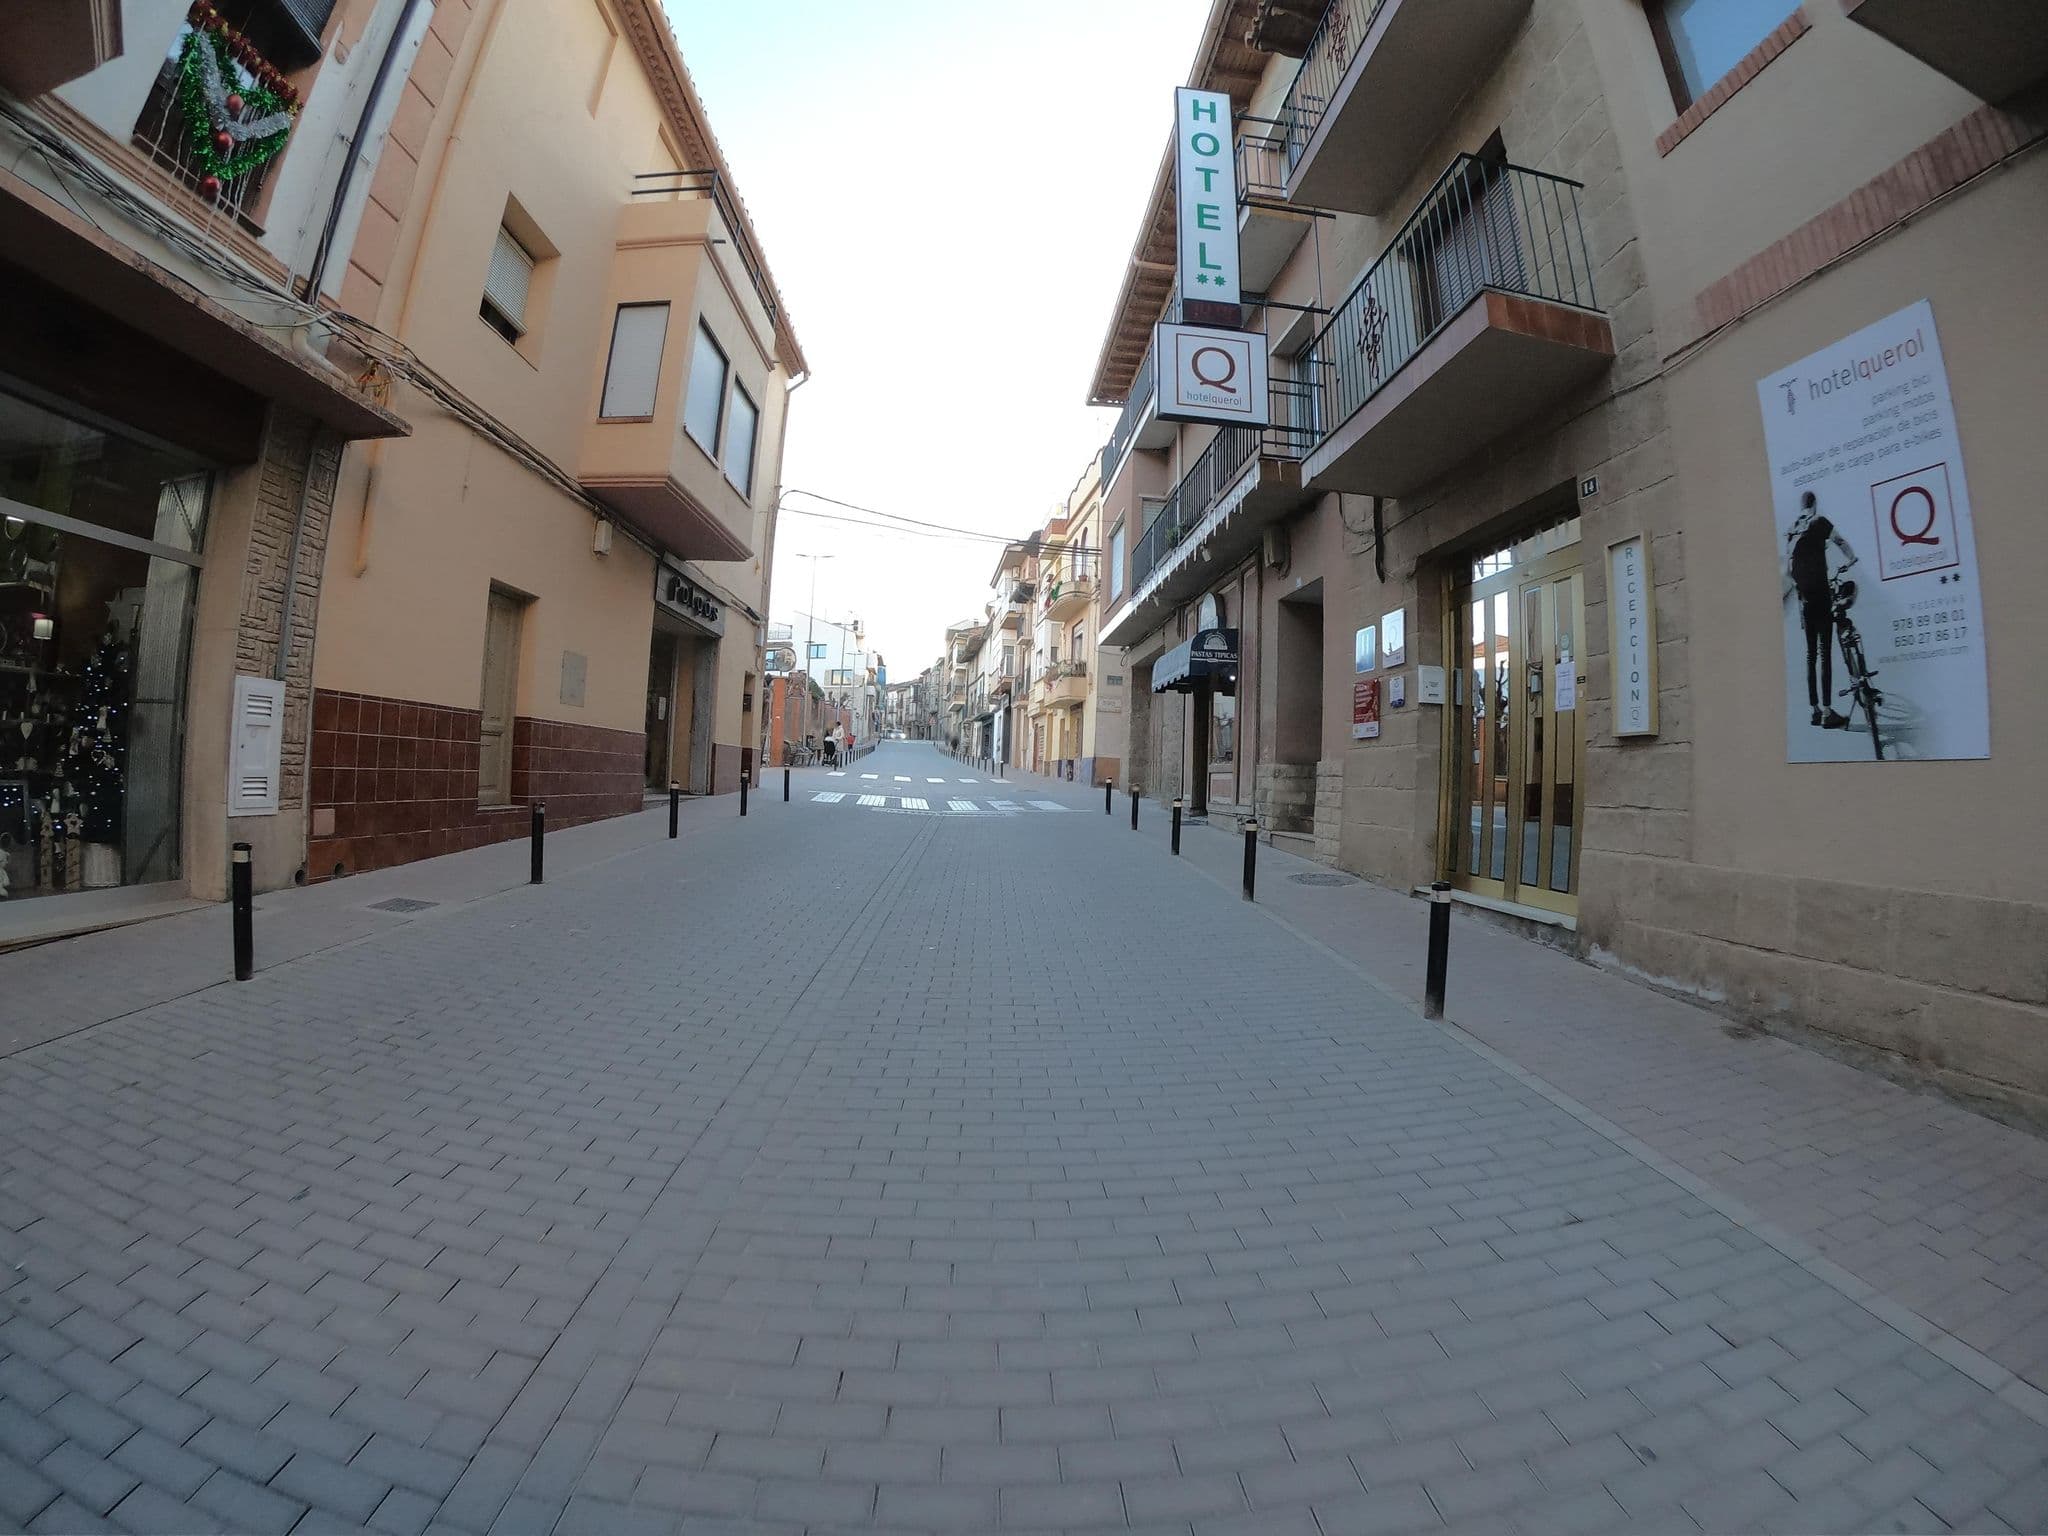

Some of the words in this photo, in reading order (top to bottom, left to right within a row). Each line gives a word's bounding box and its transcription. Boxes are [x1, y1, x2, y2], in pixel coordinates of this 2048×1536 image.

[1191, 99, 1222, 270] HOTEL
[1190, 346, 1238, 395] Q
[1808, 329, 1925, 401] hotelquerol
[1185, 391, 1243, 408] hotelquerol
[1861, 405, 1901, 430] parking
[1901, 391, 1936, 409] motos
[1870, 383, 1911, 406] parking
[1828, 446, 1841, 458] de
[1896, 420, 1911, 433] de
[1833, 461, 1846, 474] de
[1876, 441, 1901, 459] para
[1890, 485, 1940, 547] Q
[1625, 547, 1640, 701] RECEPCION
[1893, 617, 1913, 631] 978
[1191, 650, 1213, 658] PASTAS
